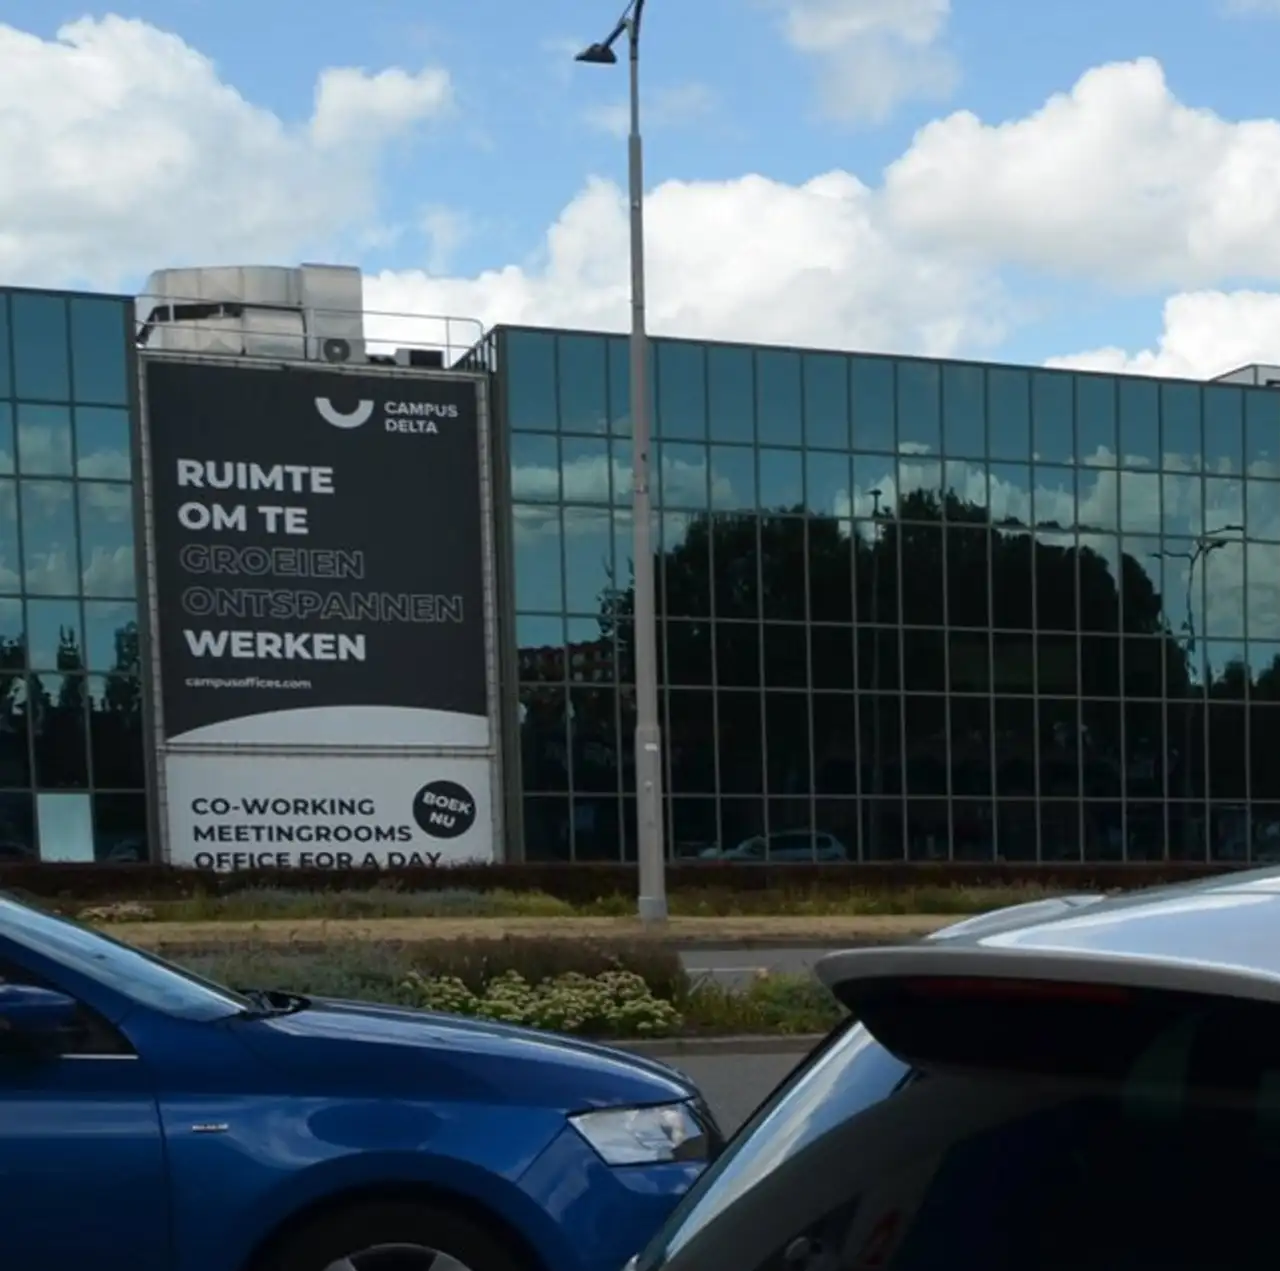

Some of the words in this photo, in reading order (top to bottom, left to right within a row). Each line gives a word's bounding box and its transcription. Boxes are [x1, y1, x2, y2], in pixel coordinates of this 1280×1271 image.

[384, 401, 459, 418] CAMPUS
[385, 419, 438, 435] DELTA
[177, 459, 335, 494] RUIMTE
[178, 502, 247, 533] OM
[258, 506, 309, 534] TE
[181, 544, 365, 579] GROEIEN
[182, 586, 464, 623] ONTSPANNEN
[184, 629, 367, 661] WERKEN
[191, 797, 376, 816] CO-WORKING
[422, 791, 472, 815] BOEK
[430, 812, 457, 828] NU
[193, 825, 413, 843] MEETINGROOMS
[194, 852, 291, 870] OFFICE
[298, 852, 354, 868] FOR
[361, 852, 380, 868] A
[387, 851, 442, 868] DAY
